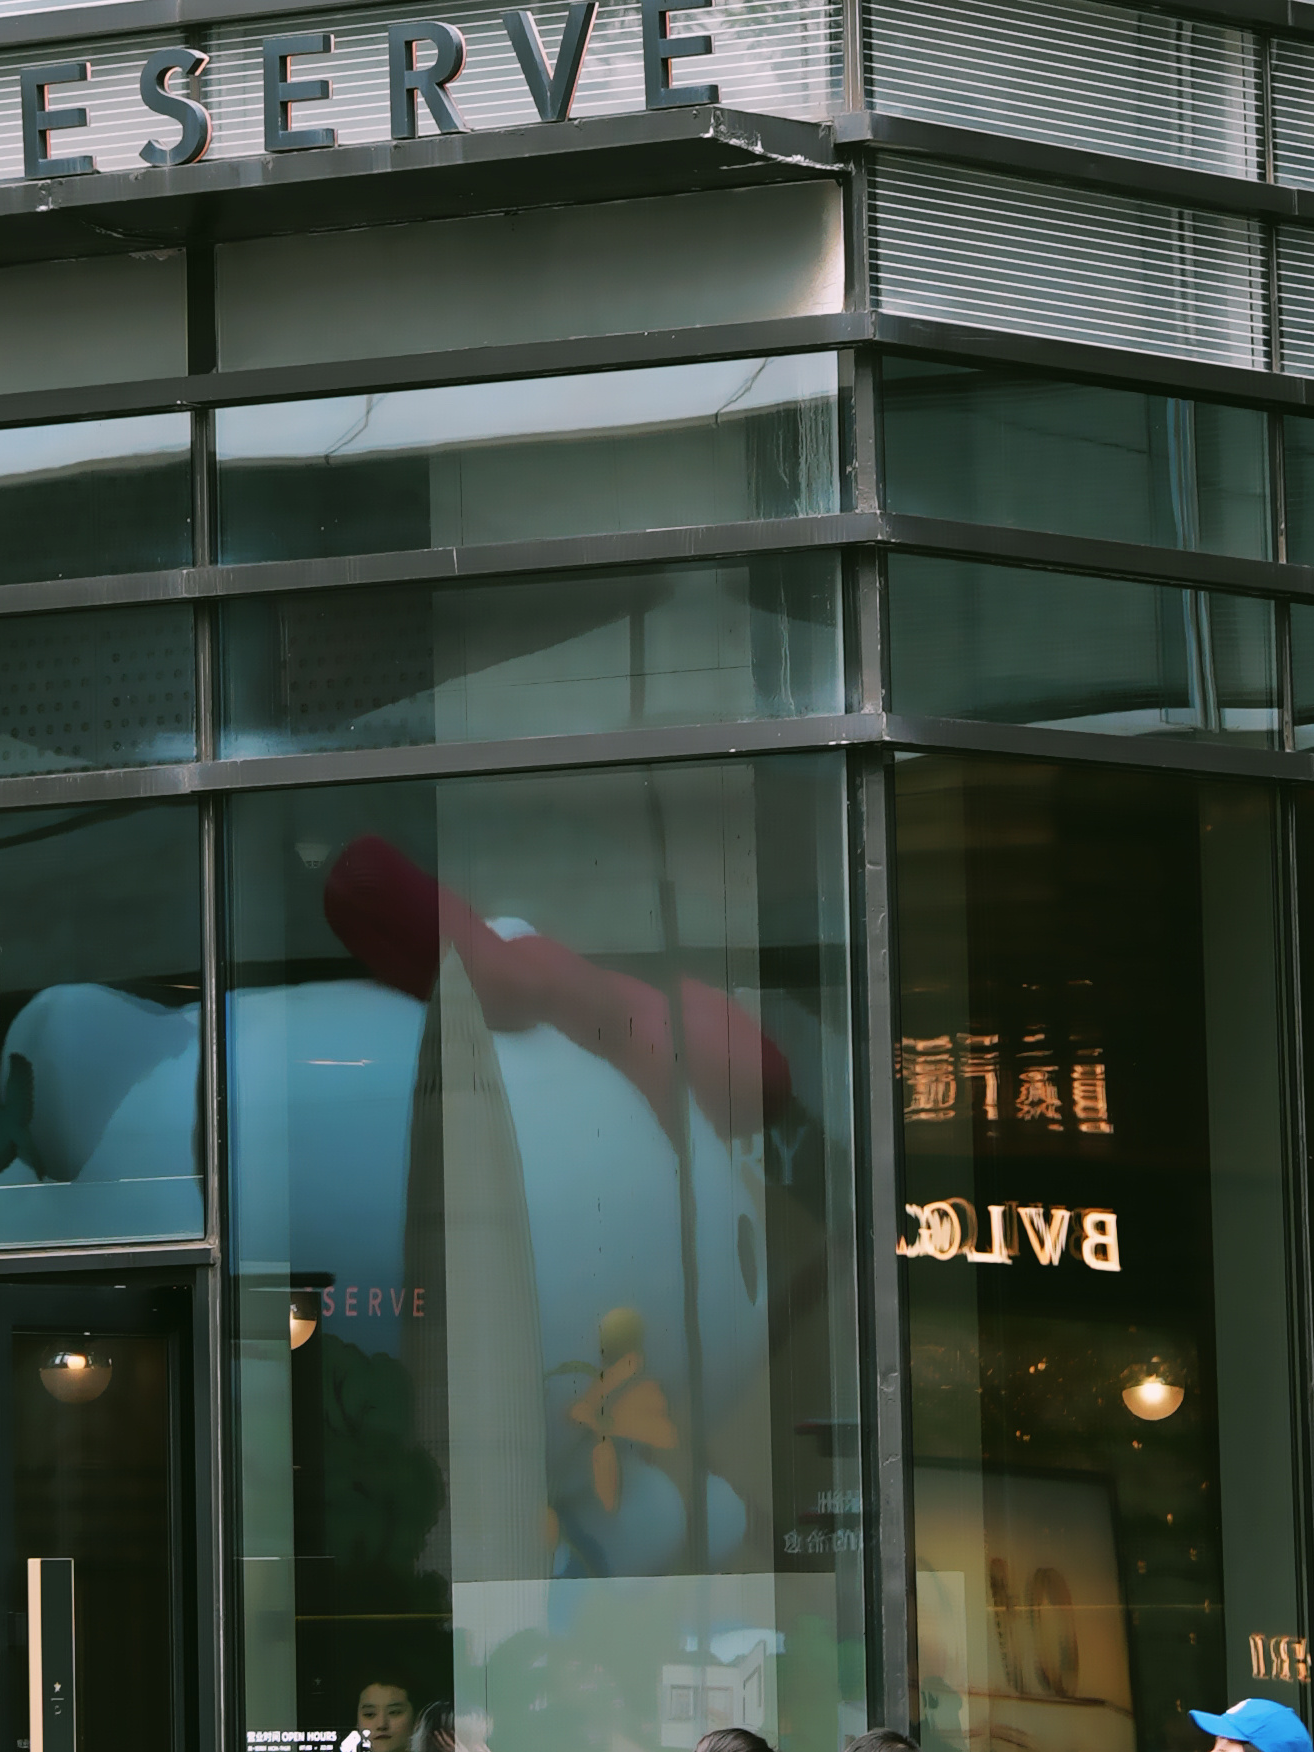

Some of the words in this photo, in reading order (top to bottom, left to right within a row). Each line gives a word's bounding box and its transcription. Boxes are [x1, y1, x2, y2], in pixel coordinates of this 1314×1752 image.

[321, 1285, 426, 1319] SERVE
[281, 1731, 305, 1742] OPEN
[306, 1731, 337, 1742] HOURS
